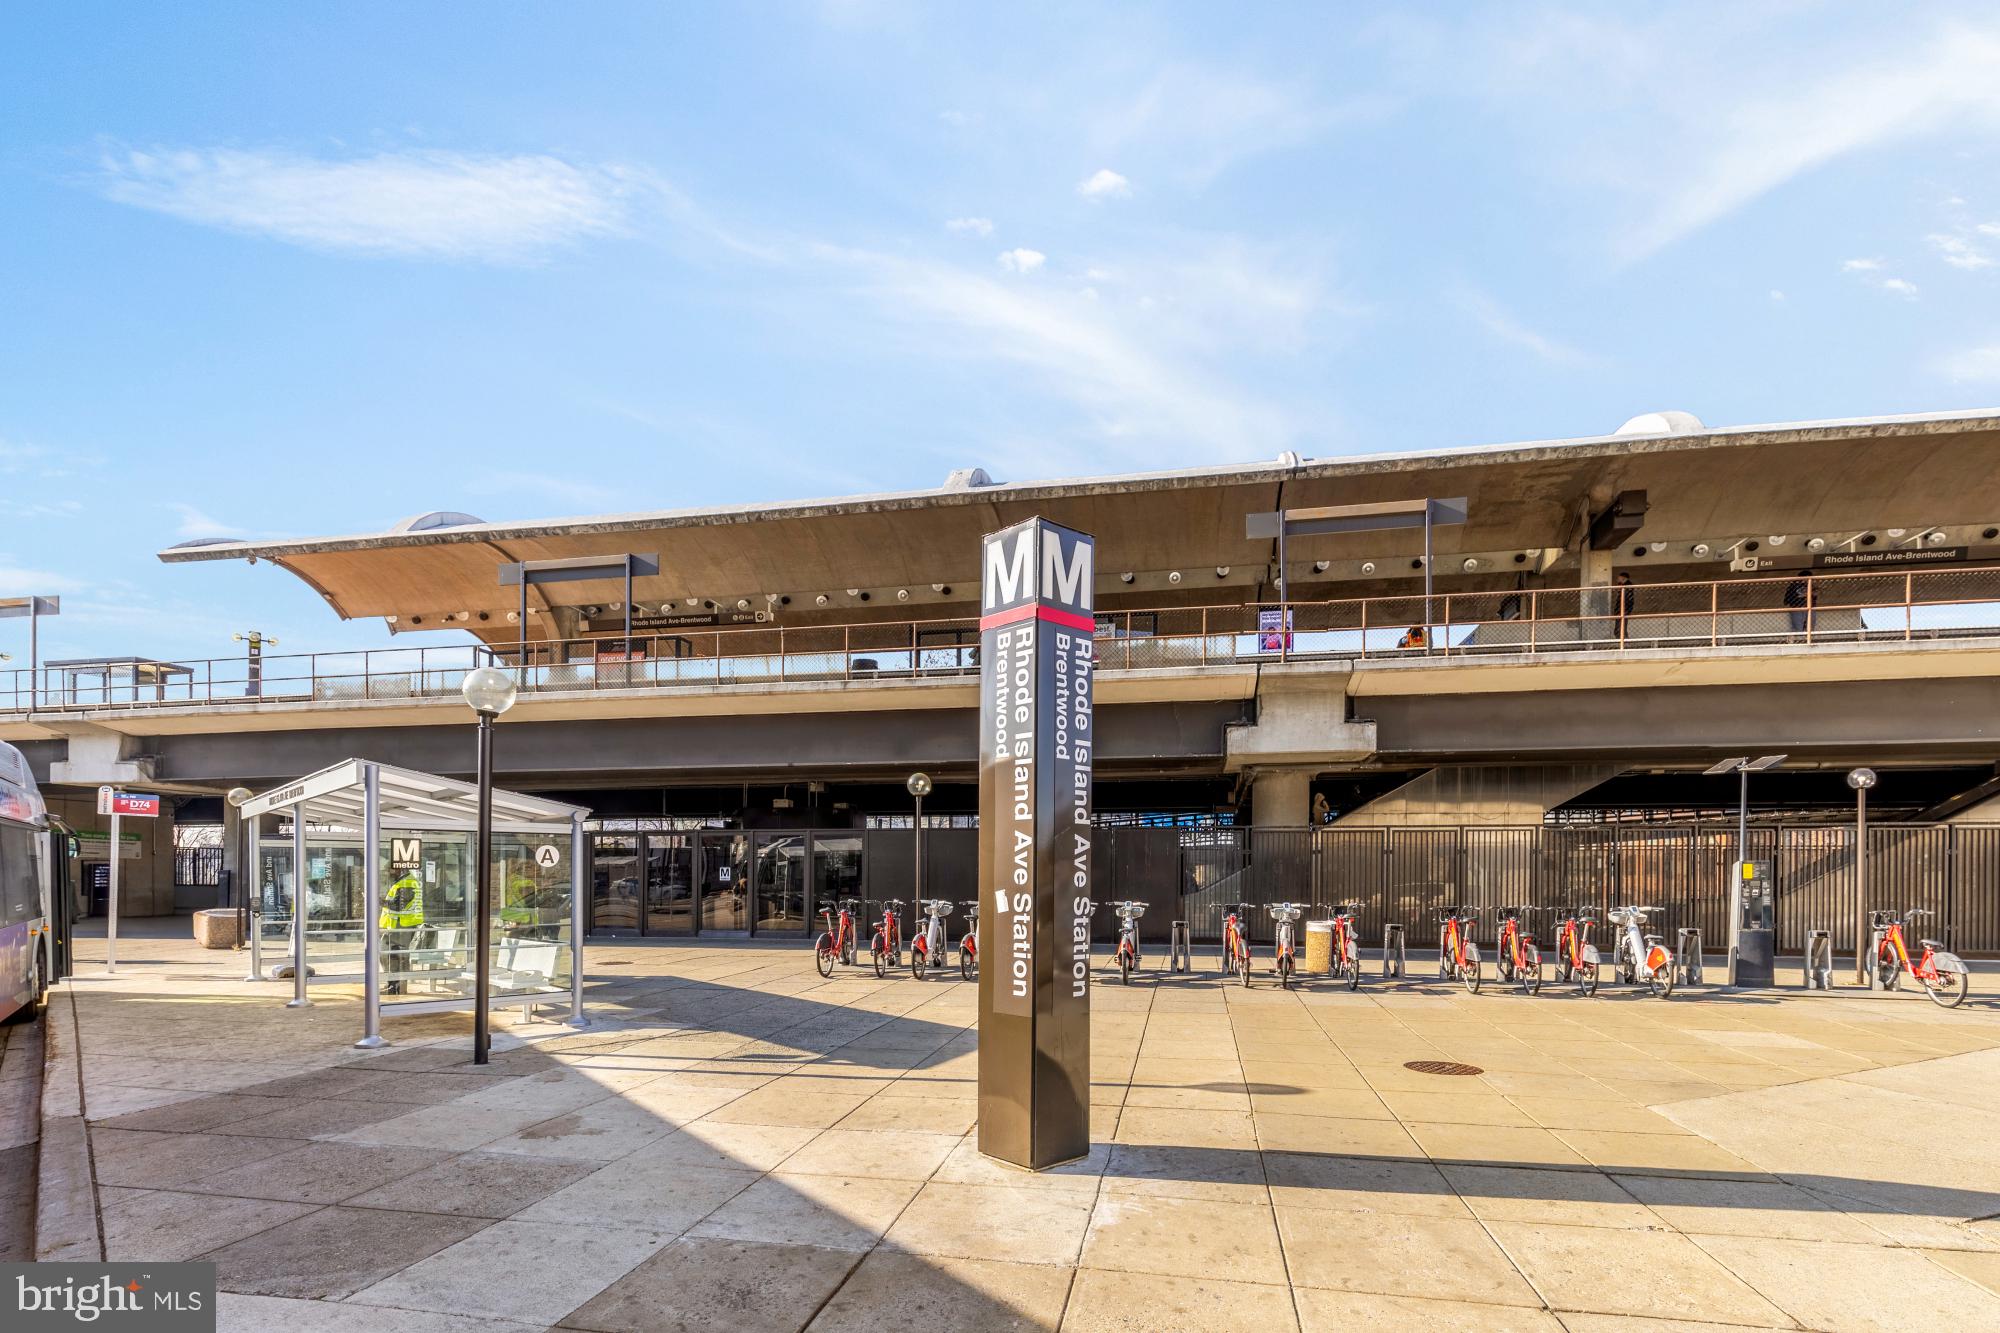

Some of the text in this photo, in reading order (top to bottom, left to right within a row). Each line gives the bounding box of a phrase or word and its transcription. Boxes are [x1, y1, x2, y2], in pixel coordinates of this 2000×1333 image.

[985, 527, 1034, 610] M
[1824, 550, 1956, 564] Rhode Island Ave-Brentwood
[1042, 528, 1092, 611] M
[668, 616, 712, 624] Ave-Brentwood
[995, 631, 1012, 759] Brentwood
[1056, 632, 1071, 760] Brentwood
[130, 800, 151, 809] D74
[1012, 626, 1034, 997] Rhode Island Ave Station
[1072, 637, 1093, 998] Rhode Island Ave Station
[393, 839, 420, 862] M
[540, 848, 555, 864] A
[393, 861, 420, 869] metro
[721, 868, 730, 877] M
